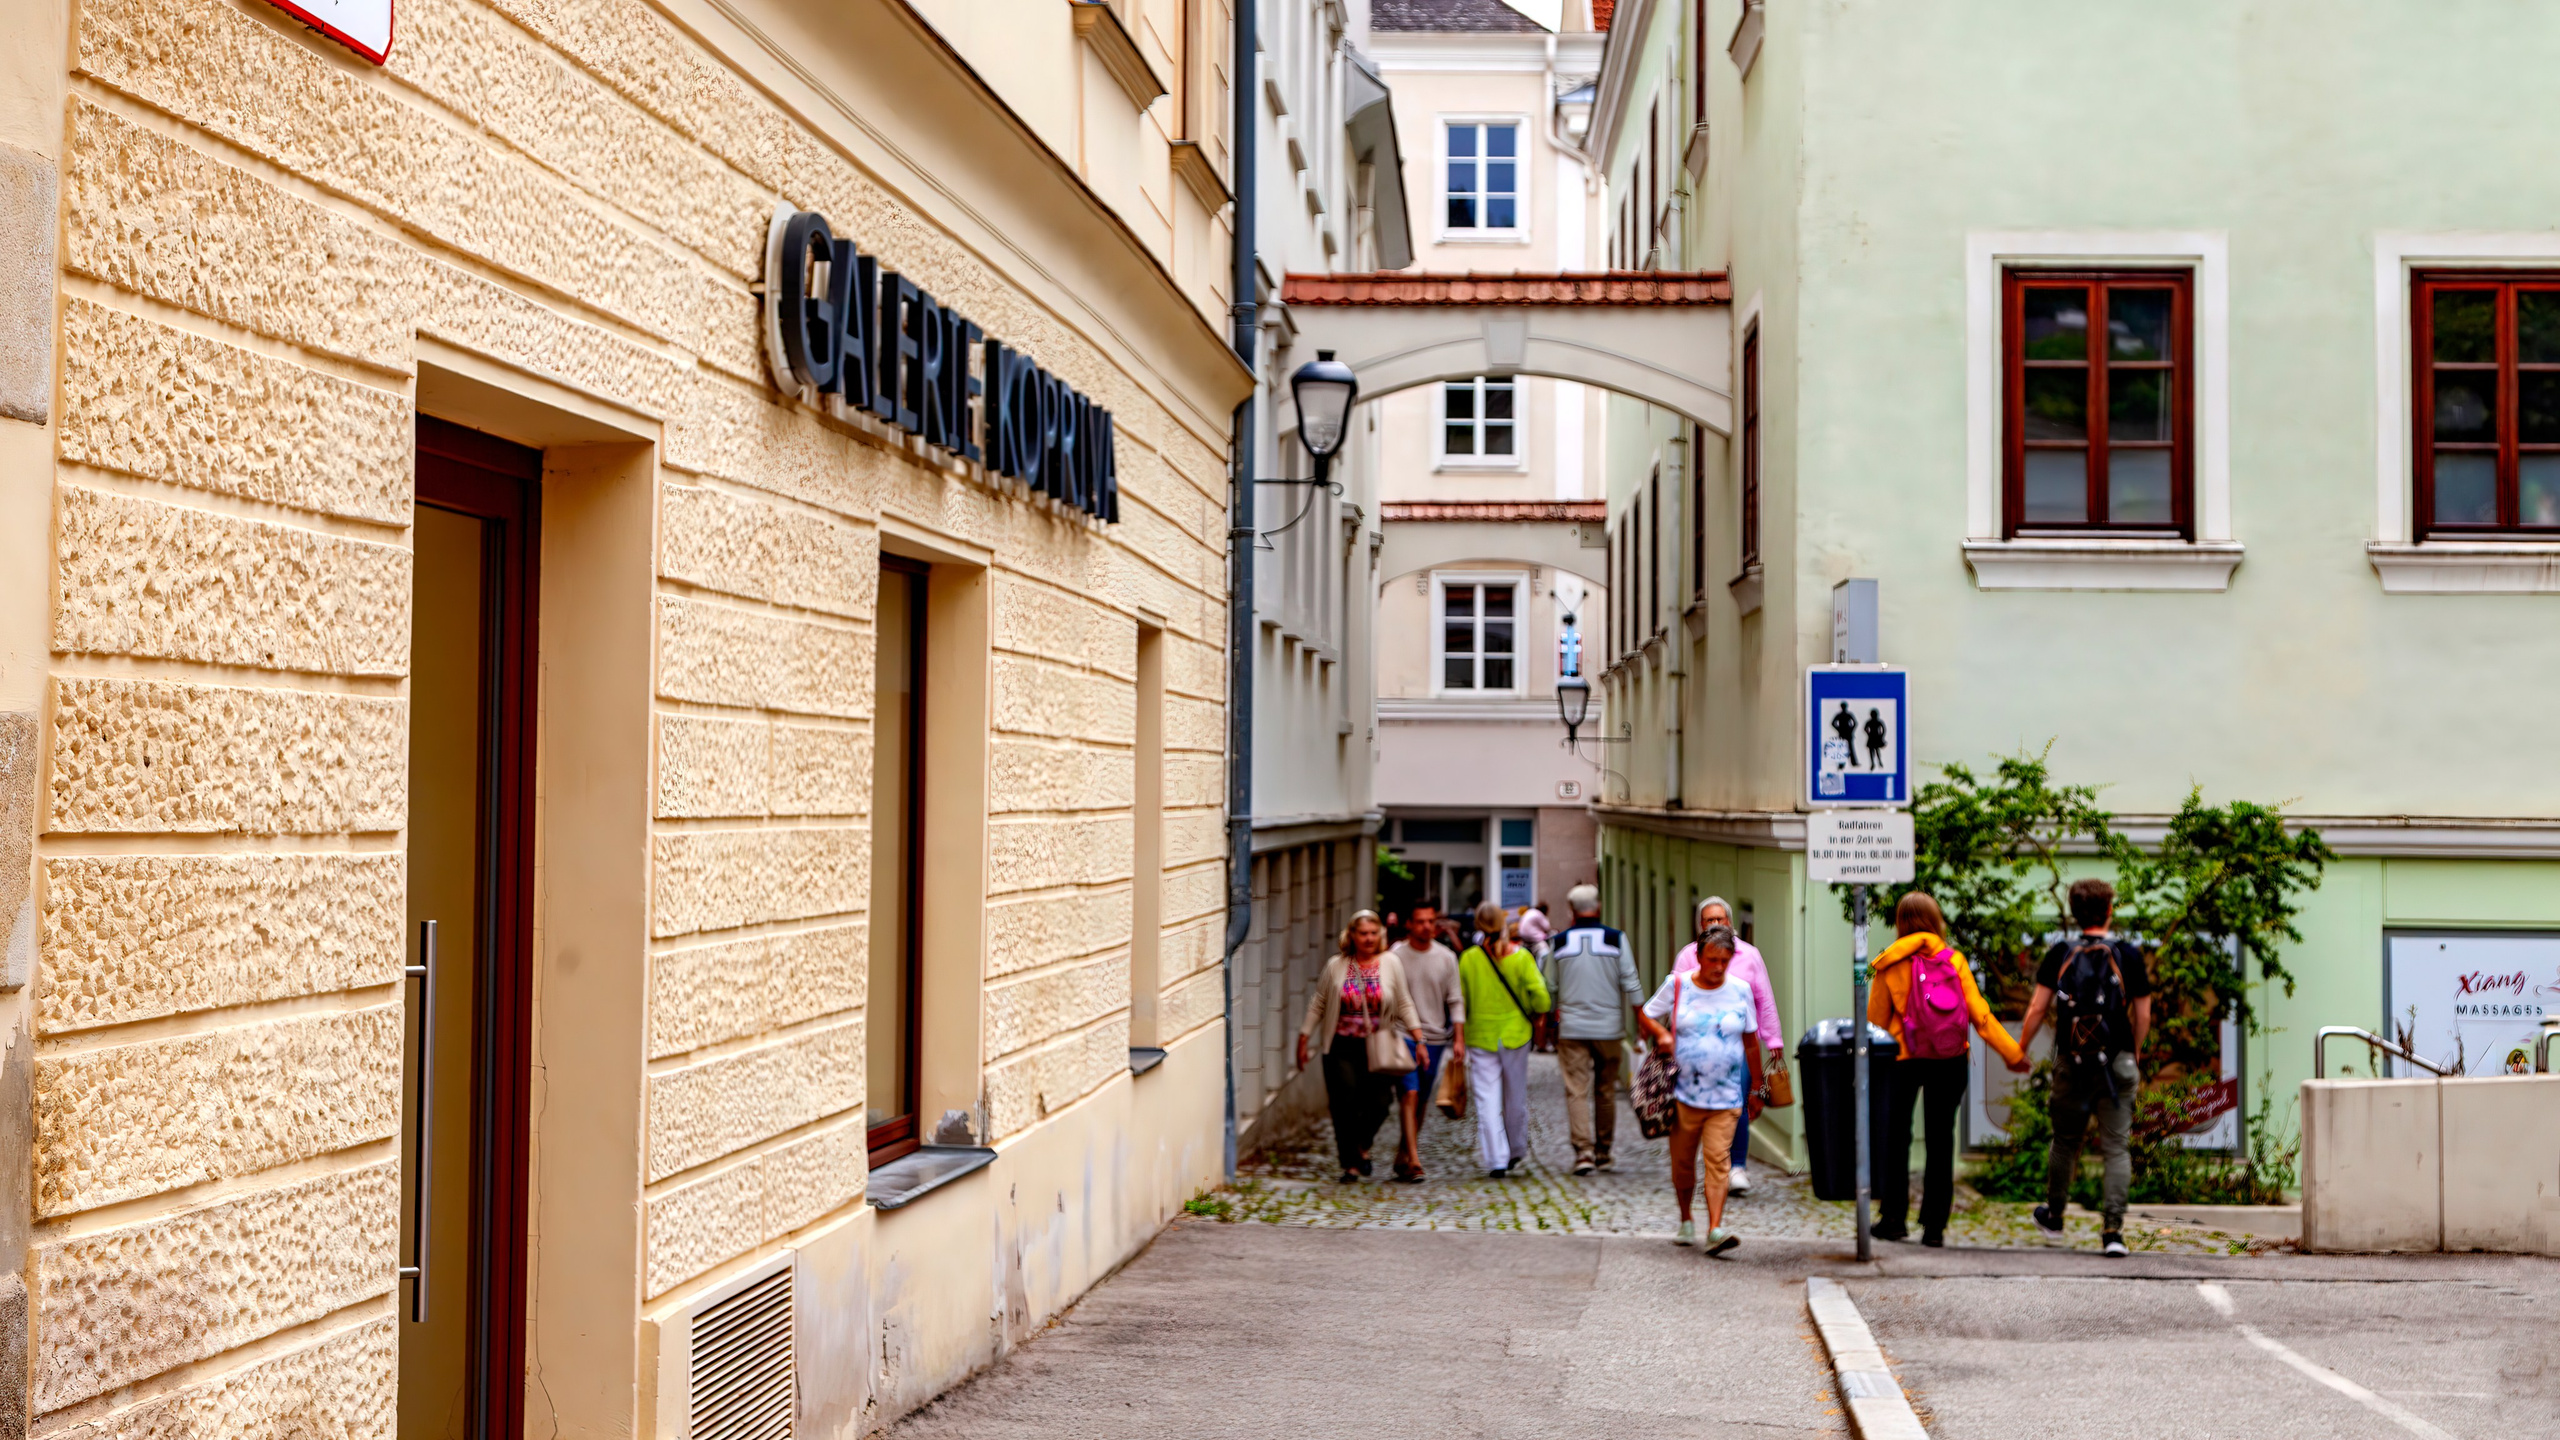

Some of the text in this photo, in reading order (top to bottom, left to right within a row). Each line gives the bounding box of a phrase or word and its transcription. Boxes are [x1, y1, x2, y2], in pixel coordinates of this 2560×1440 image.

[776, 211, 1119, 524] GALERIE KOPRIVA
[1838, 820, 1883, 830] Radfahren
[1829, 835, 1893, 844] in der Zeit von
[1837, 849, 1851, 859] Uhr
[1853, 849, 1867, 859] bis
[1895, 849, 1910, 859] Uhr
[1841, 865, 1881, 875] gestattet
[2454, 970, 2530, 1001] Xiang
